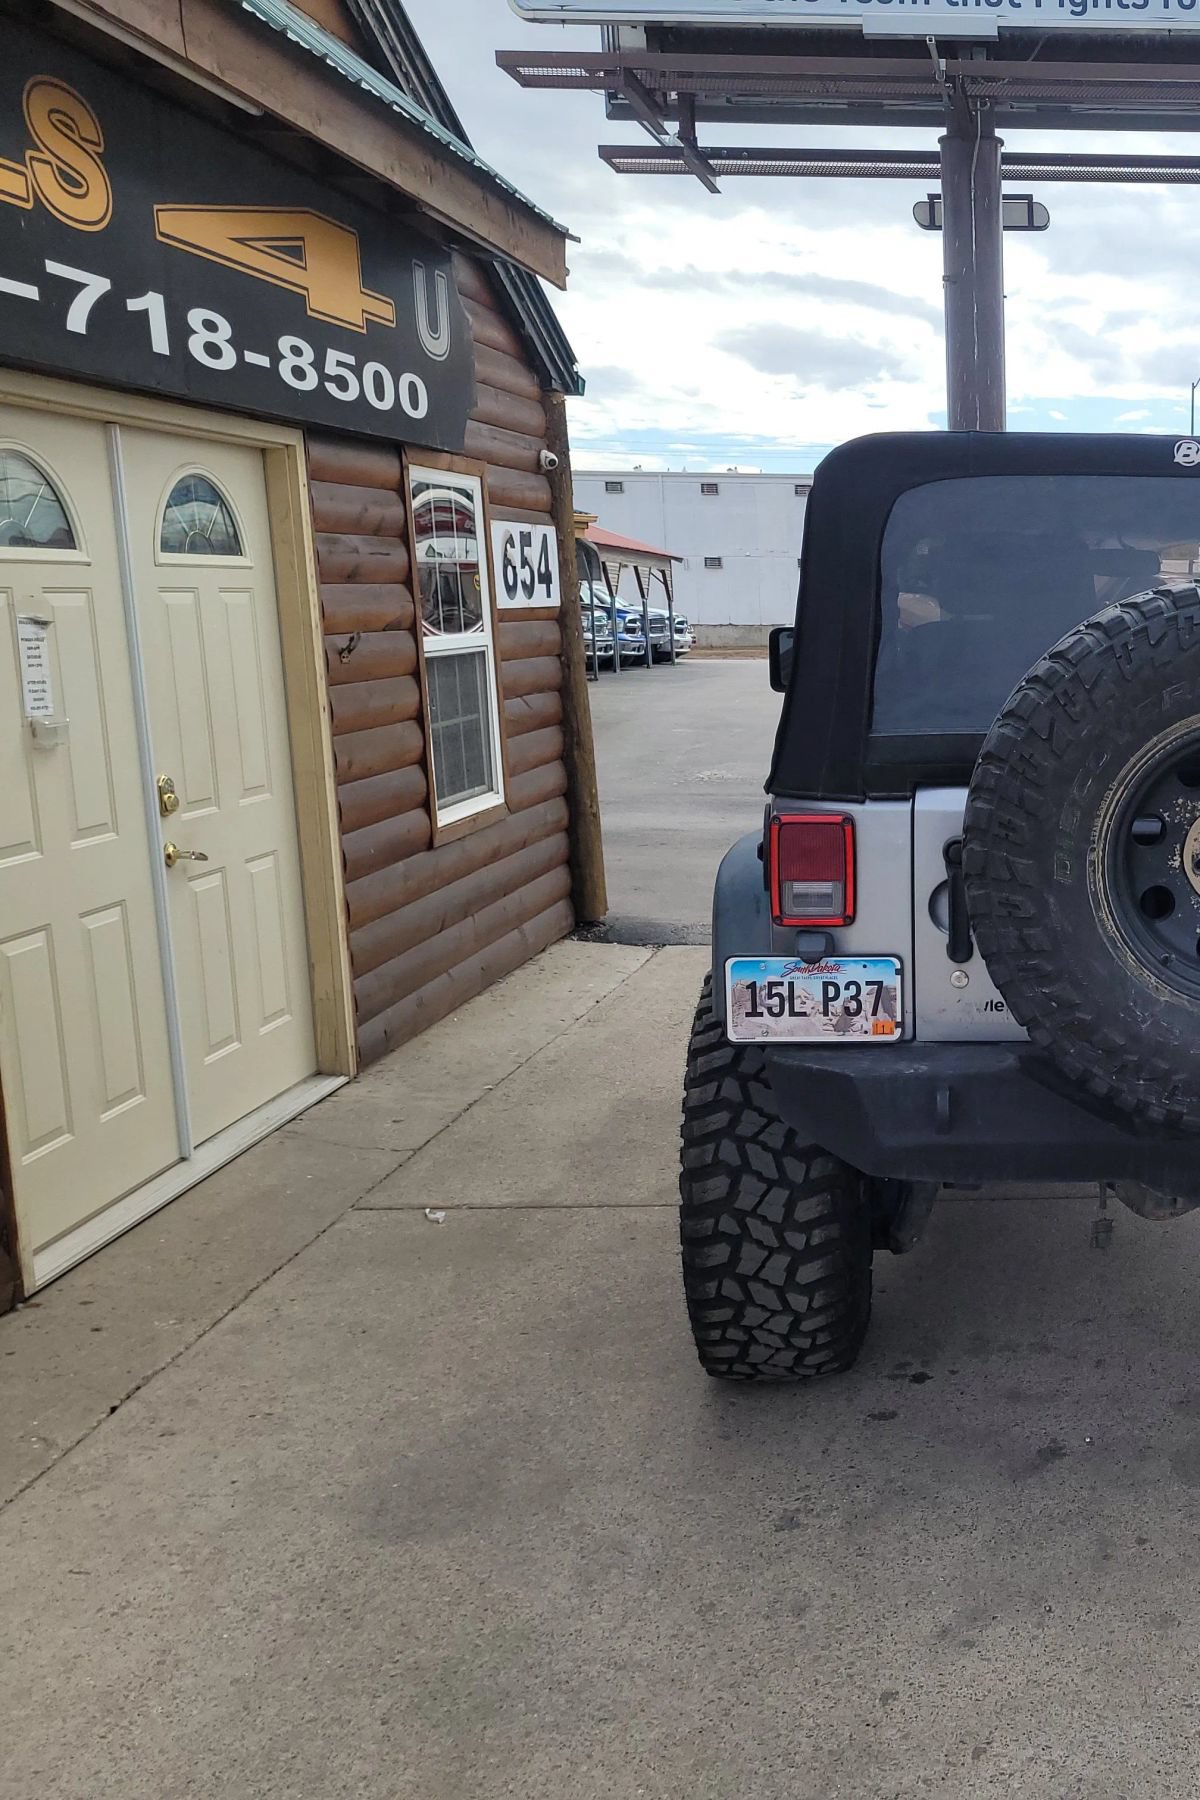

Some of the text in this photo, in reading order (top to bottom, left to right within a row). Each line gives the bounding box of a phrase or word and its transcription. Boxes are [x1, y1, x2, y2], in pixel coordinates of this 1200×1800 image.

[153, 203, 397, 334] 4
[412, 258, 451, 362] U
[503, 529, 552, 600] 654
[745, 981, 883, 1018] 15L P37
